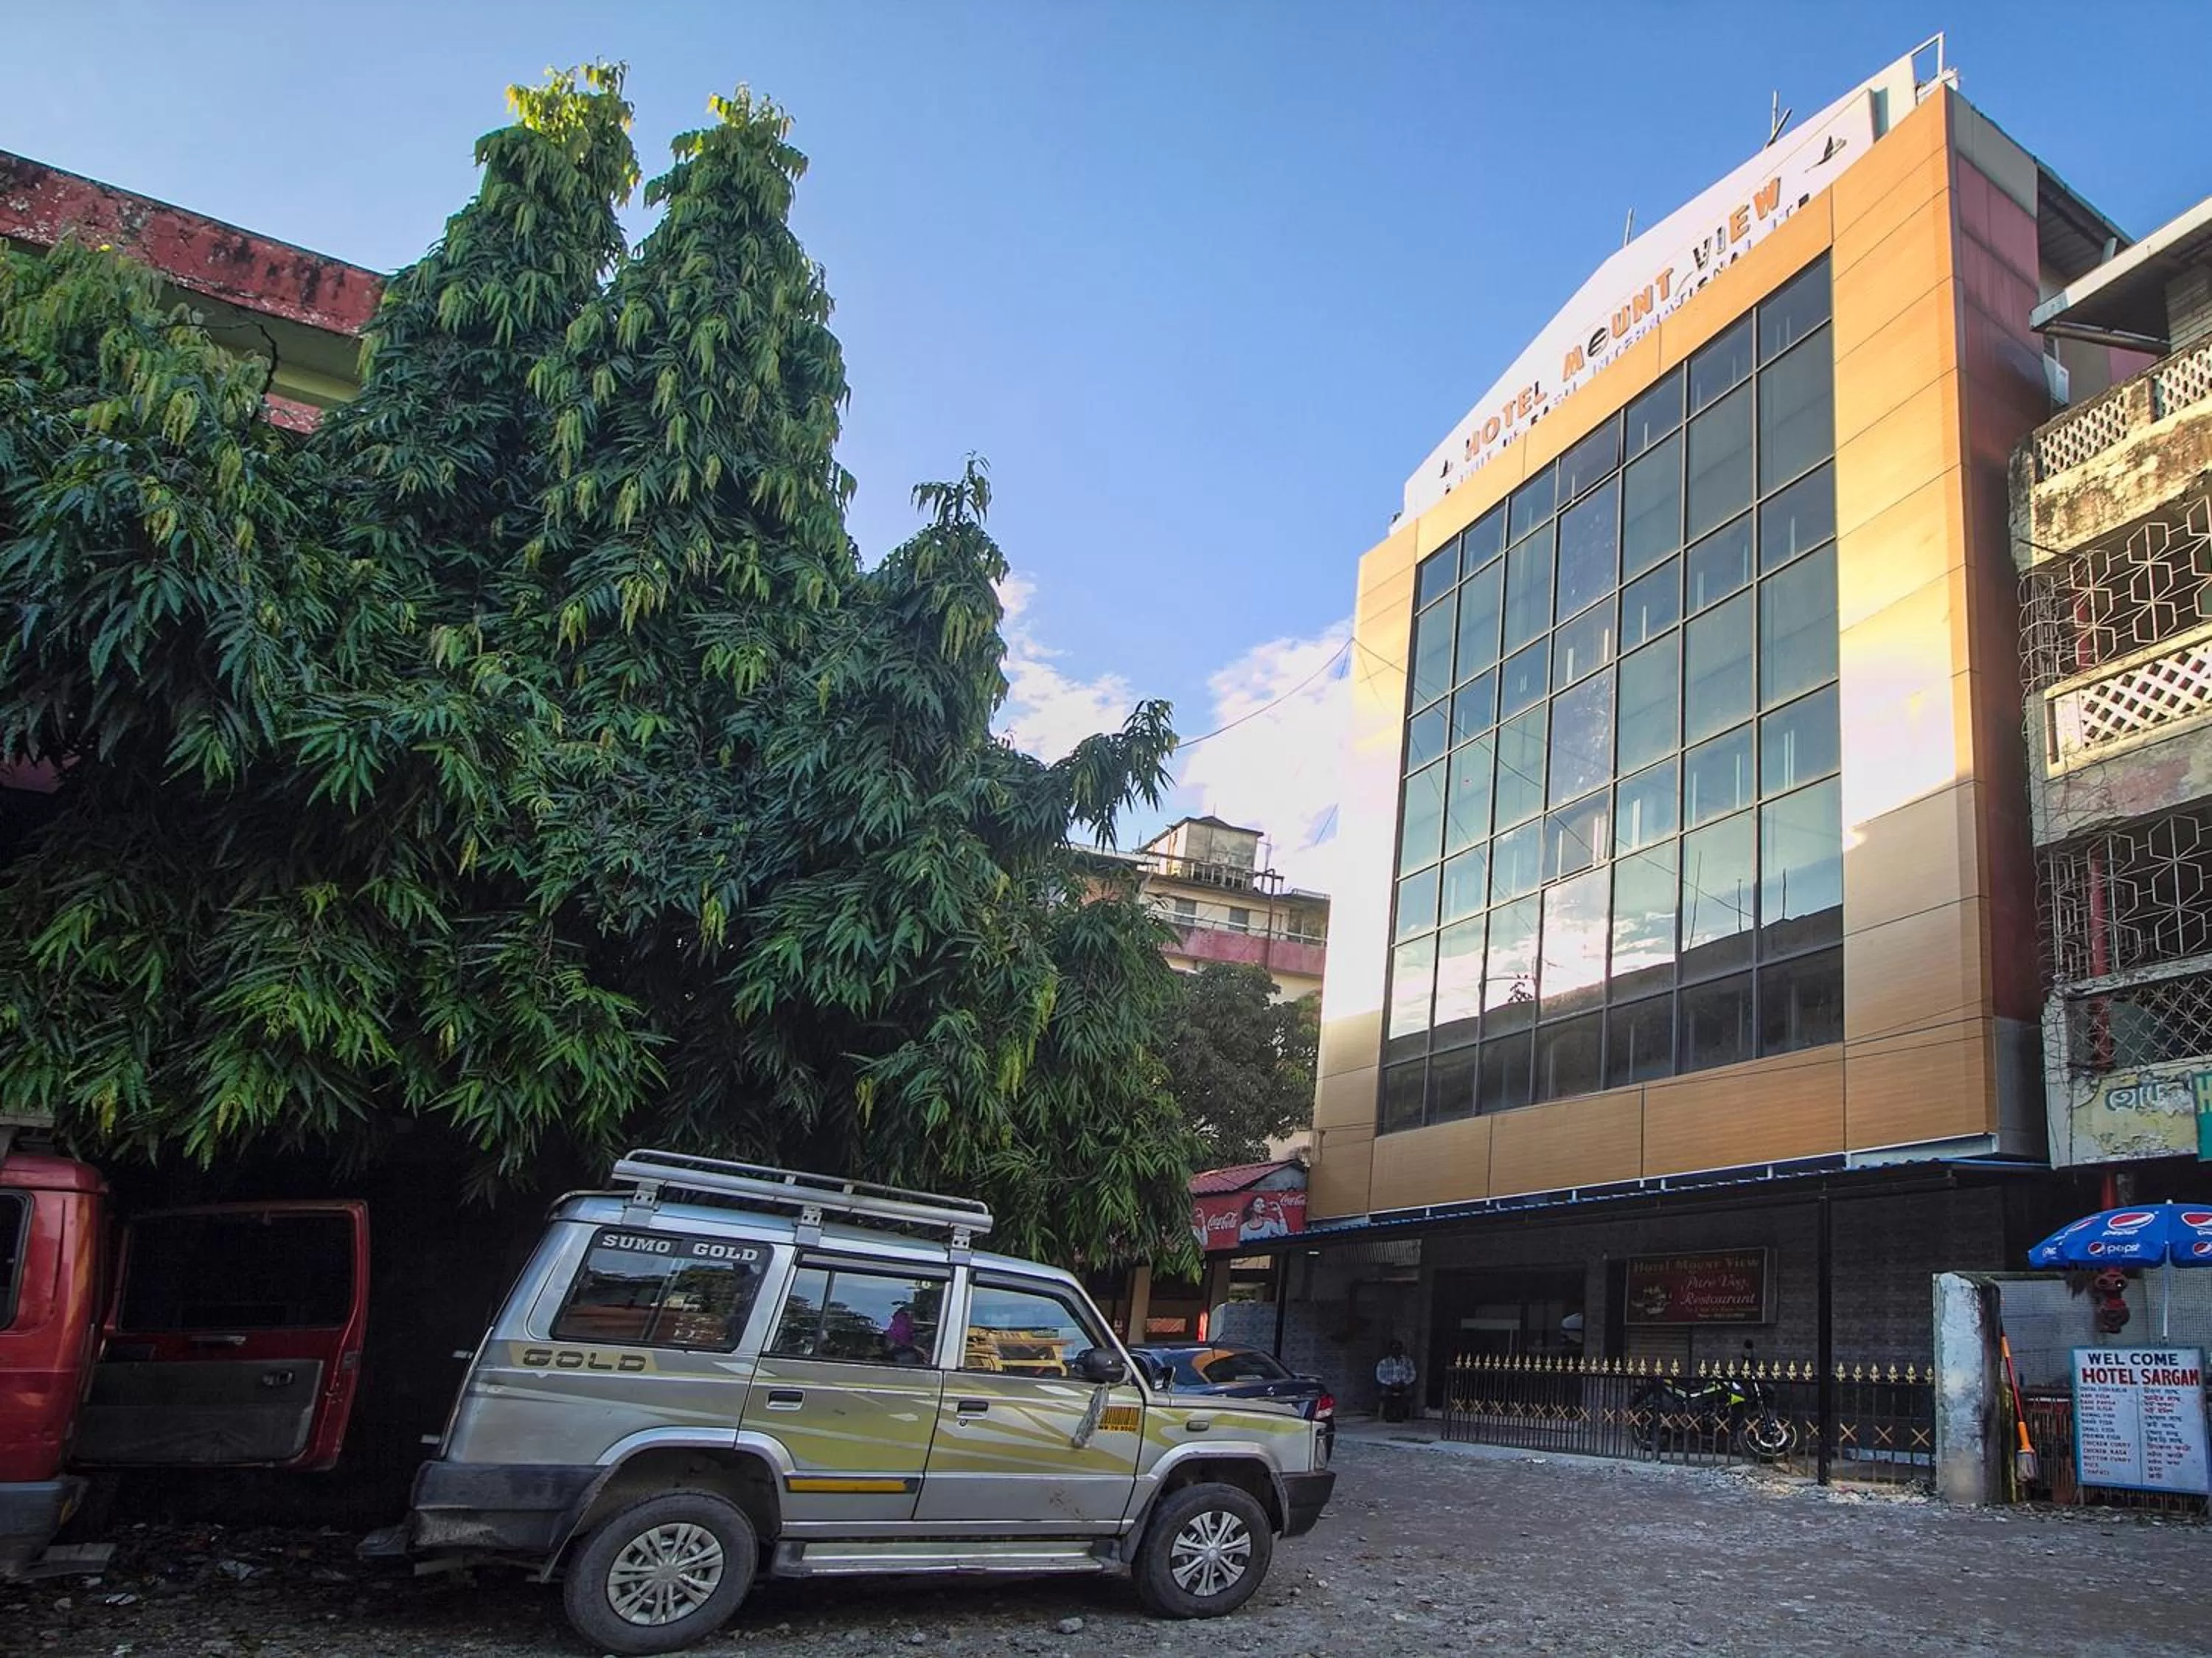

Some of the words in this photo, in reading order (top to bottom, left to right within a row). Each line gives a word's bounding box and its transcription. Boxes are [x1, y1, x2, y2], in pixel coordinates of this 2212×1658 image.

[1464, 381, 1548, 462] HOTEL
[1693, 176, 1781, 271] VIEW
[602, 1234, 671, 1253] SUMO
[692, 1243, 759, 1261] GOLD
[522, 1348, 647, 1371] GOLD
[2088, 1353, 2125, 1365] WEL
[2130, 1353, 2179, 1366] COME
[2081, 1367, 2138, 1385] HOTEL
[2140, 1368, 2200, 1386] SARGAM
